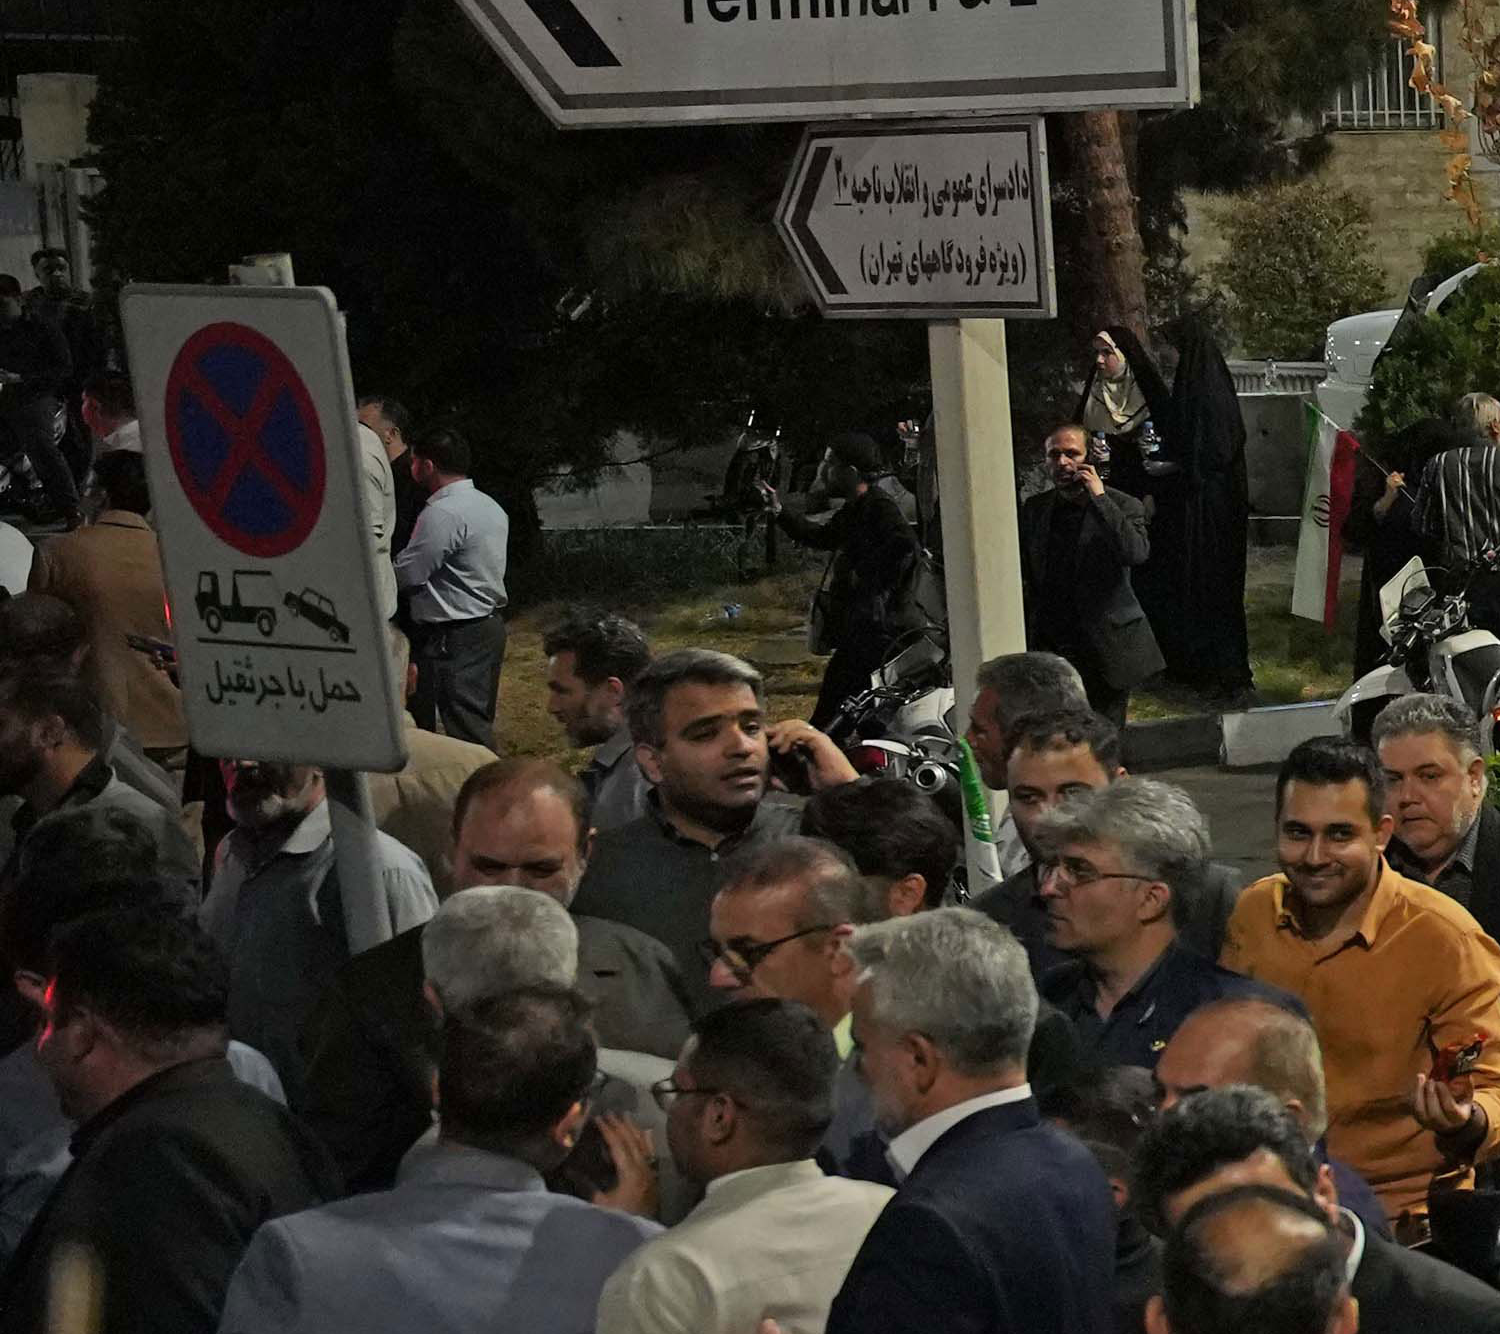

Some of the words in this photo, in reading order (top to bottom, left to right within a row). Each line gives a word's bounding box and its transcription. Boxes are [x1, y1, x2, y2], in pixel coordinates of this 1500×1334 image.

[852, 165, 881, 215] ناحیه
[883, 162, 920, 215] انقلاب
[922, 181, 929, 217] و
[932, 172, 972, 217] عمومی
[975, 161, 1029, 217] دادسرای
[206, 656, 286, 710] جرثقیل
[287, 666, 306, 710] با
[309, 666, 361, 713] حمل
